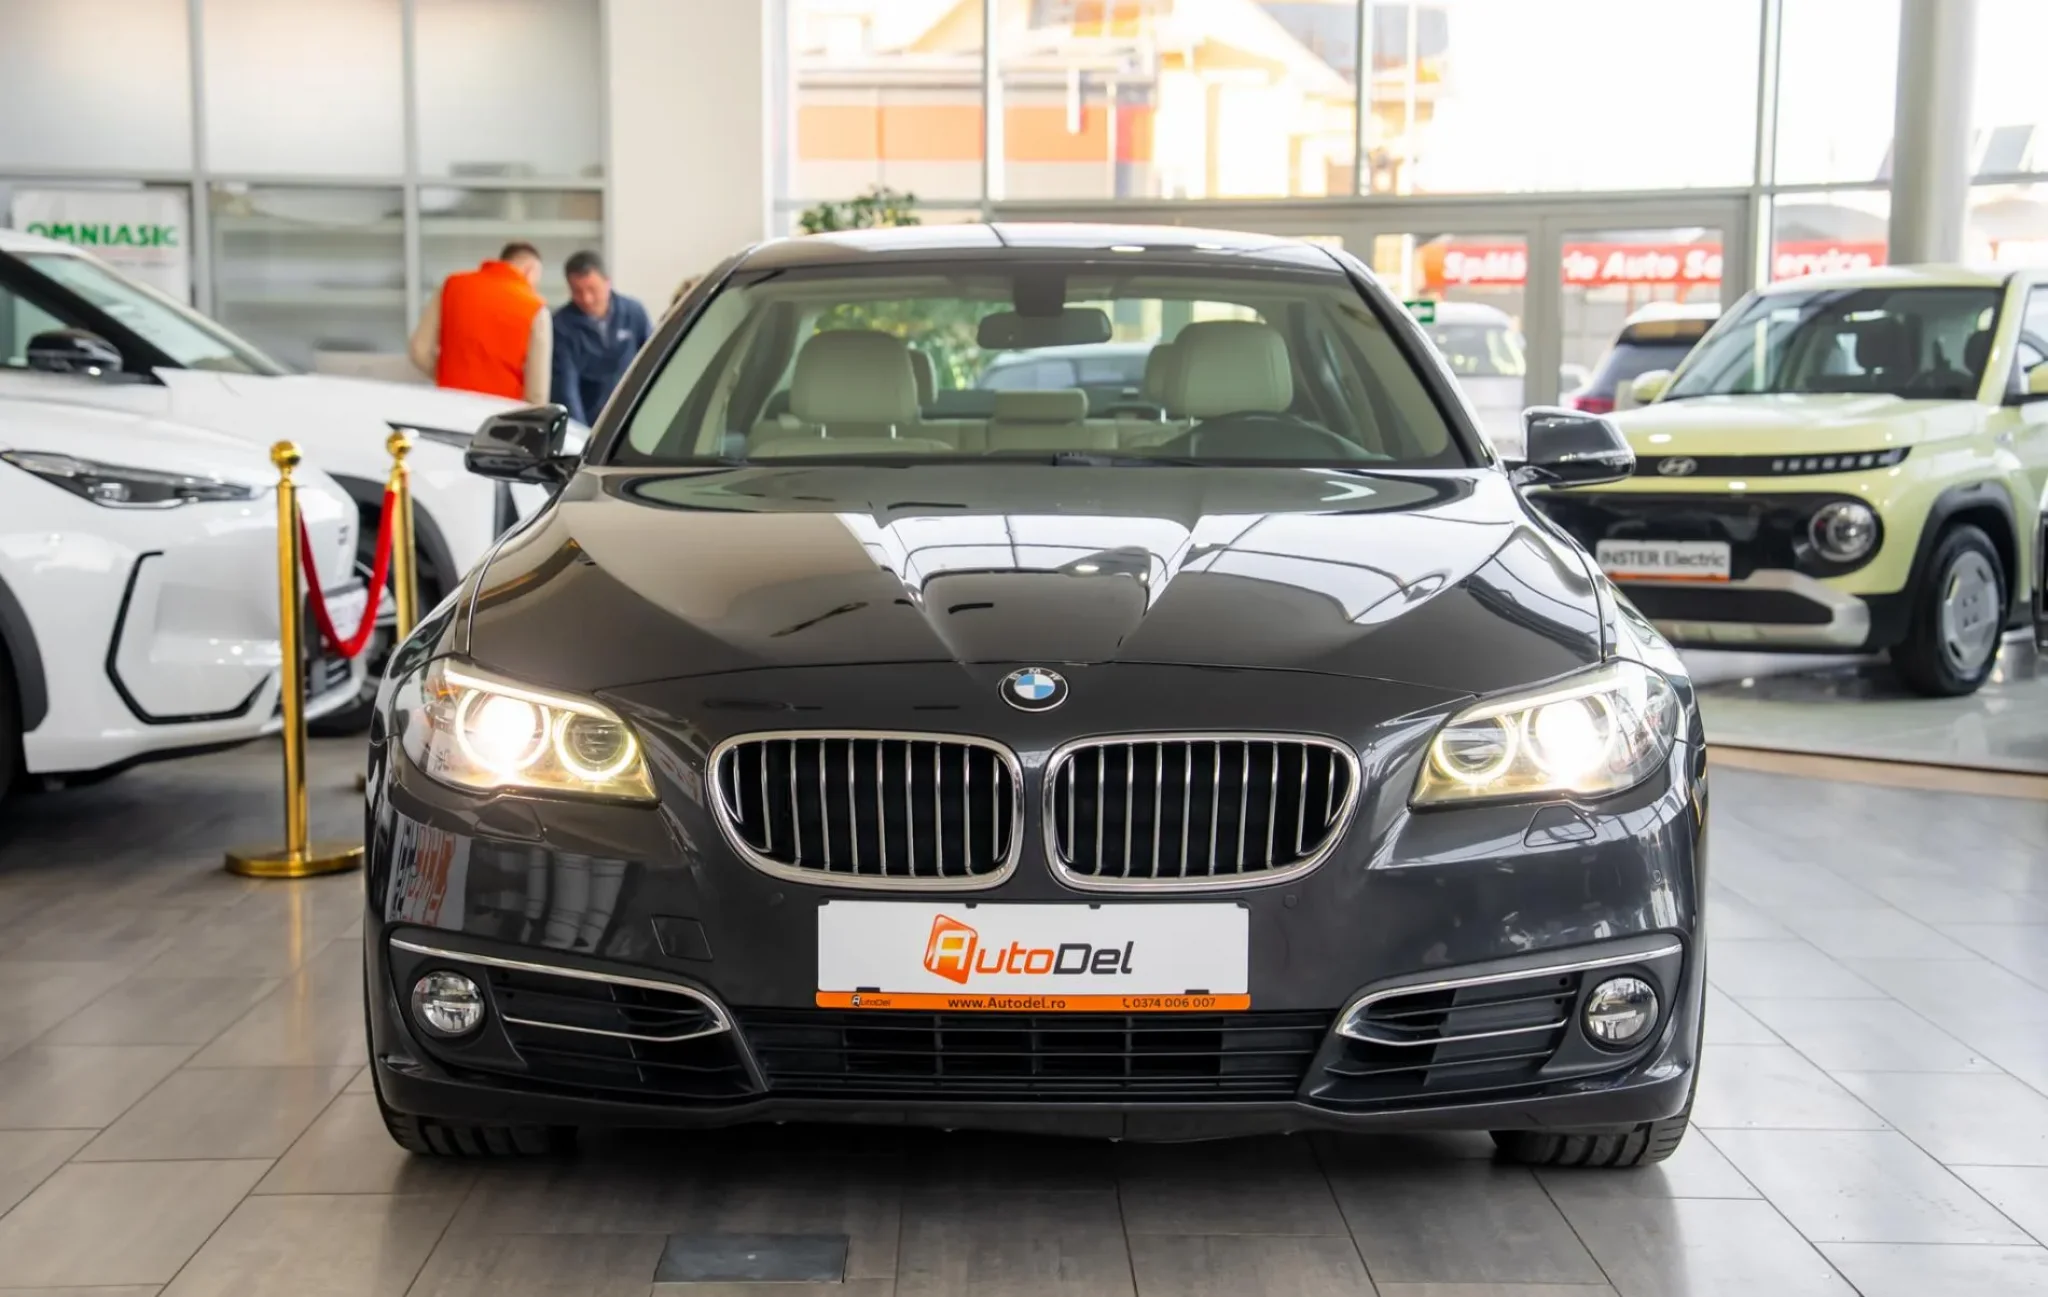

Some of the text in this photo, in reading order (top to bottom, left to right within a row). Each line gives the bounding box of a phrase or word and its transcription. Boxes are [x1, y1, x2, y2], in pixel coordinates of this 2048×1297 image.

[1602, 250, 1679, 279] Auto
[1664, 550, 1726, 566] Electric
[1008, 667, 1062, 681] BMW
[929, 927, 1134, 975] AutoDel
[948, 996, 1066, 1009] www.Autodel.ro
[1132, 997, 1216, 1009] 0374 006 007
